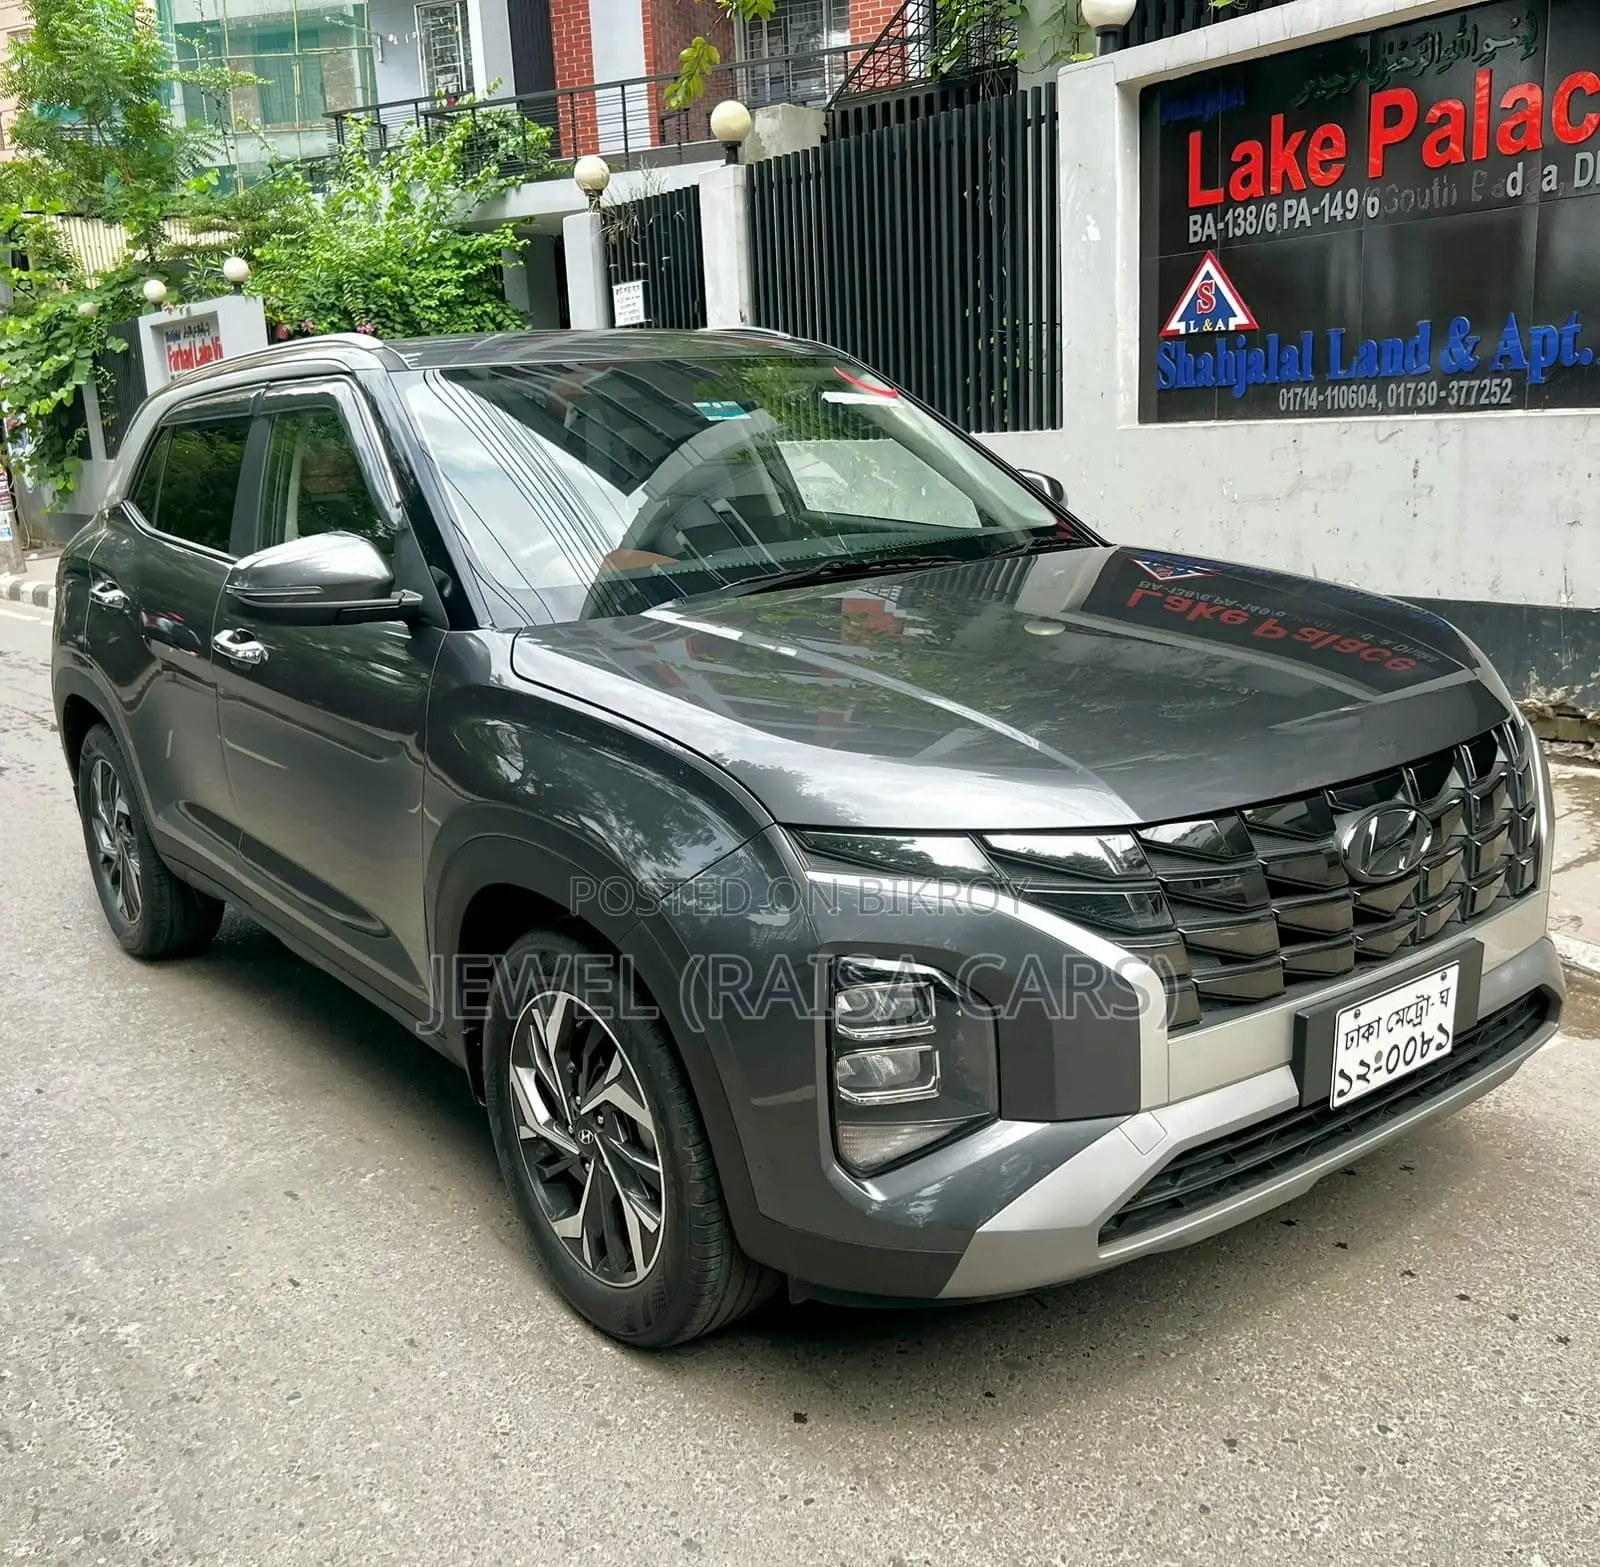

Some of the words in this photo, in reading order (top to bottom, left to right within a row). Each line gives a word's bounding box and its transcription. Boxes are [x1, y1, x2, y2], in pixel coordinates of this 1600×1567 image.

[1188, 113, 1347, 208] Lake
[1196, 280, 1216, 314] S
[1189, 320, 1199, 333] L
[1202, 318, 1213, 332] &
[1214, 318, 1226, 331] A
[1157, 331, 1315, 398] Shahjalal
[1326, 319, 1432, 380] Land
[1439, 316, 1481, 374] &
[1488, 311, 1593, 384] Apt.
[1278, 384, 1383, 412] 01714-110604,
[1344, 1016, 1383, 1051] ঢাকা
[1337, 1023, 1451, 1098] ১২-০০৮১
